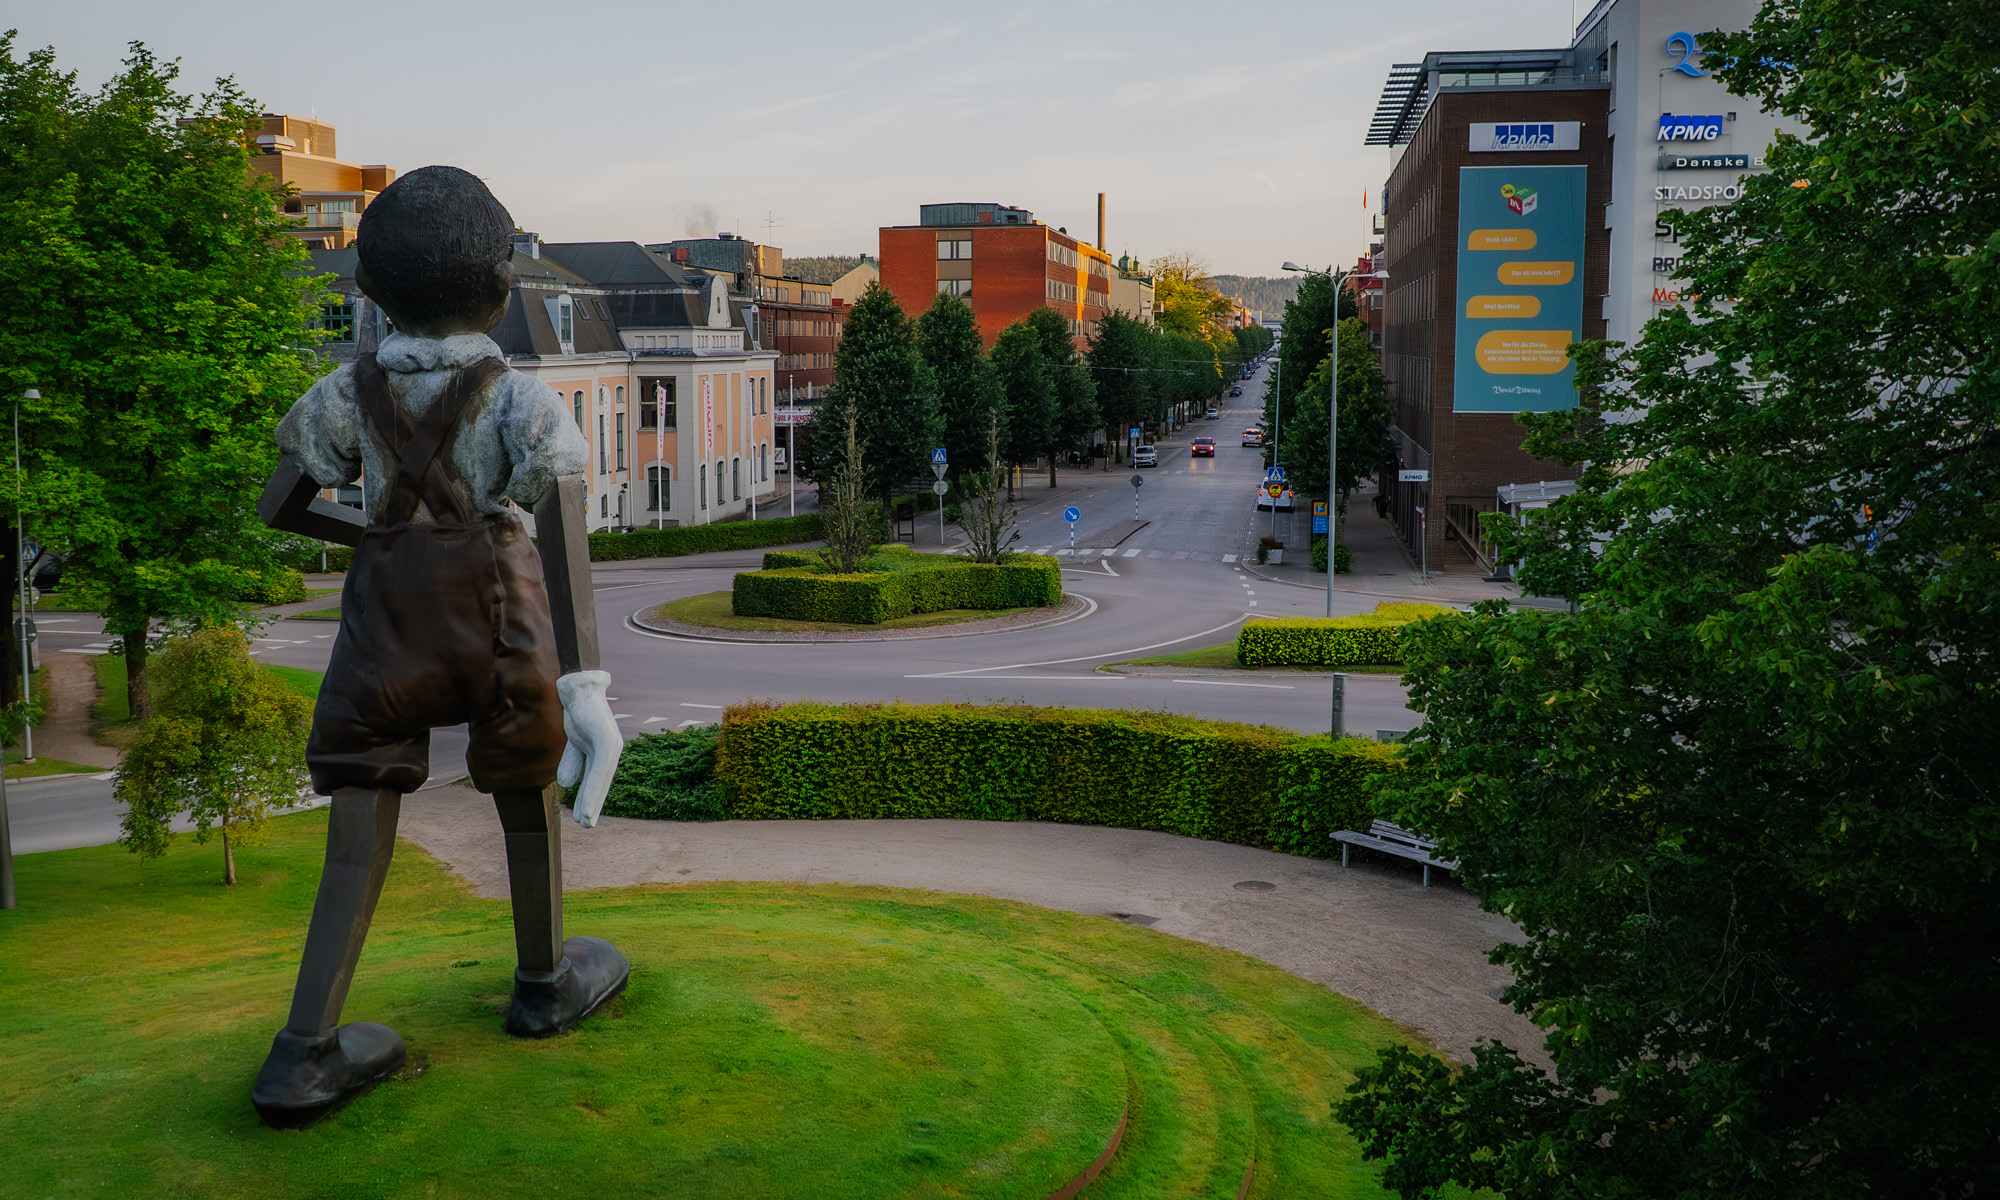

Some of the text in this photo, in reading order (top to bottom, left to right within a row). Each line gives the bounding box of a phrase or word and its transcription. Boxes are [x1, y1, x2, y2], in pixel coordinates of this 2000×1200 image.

[1656, 125, 1719, 141] KPMG
[1491, 134, 1550, 150] KPMG
[1676, 157, 1745, 167] Danske
